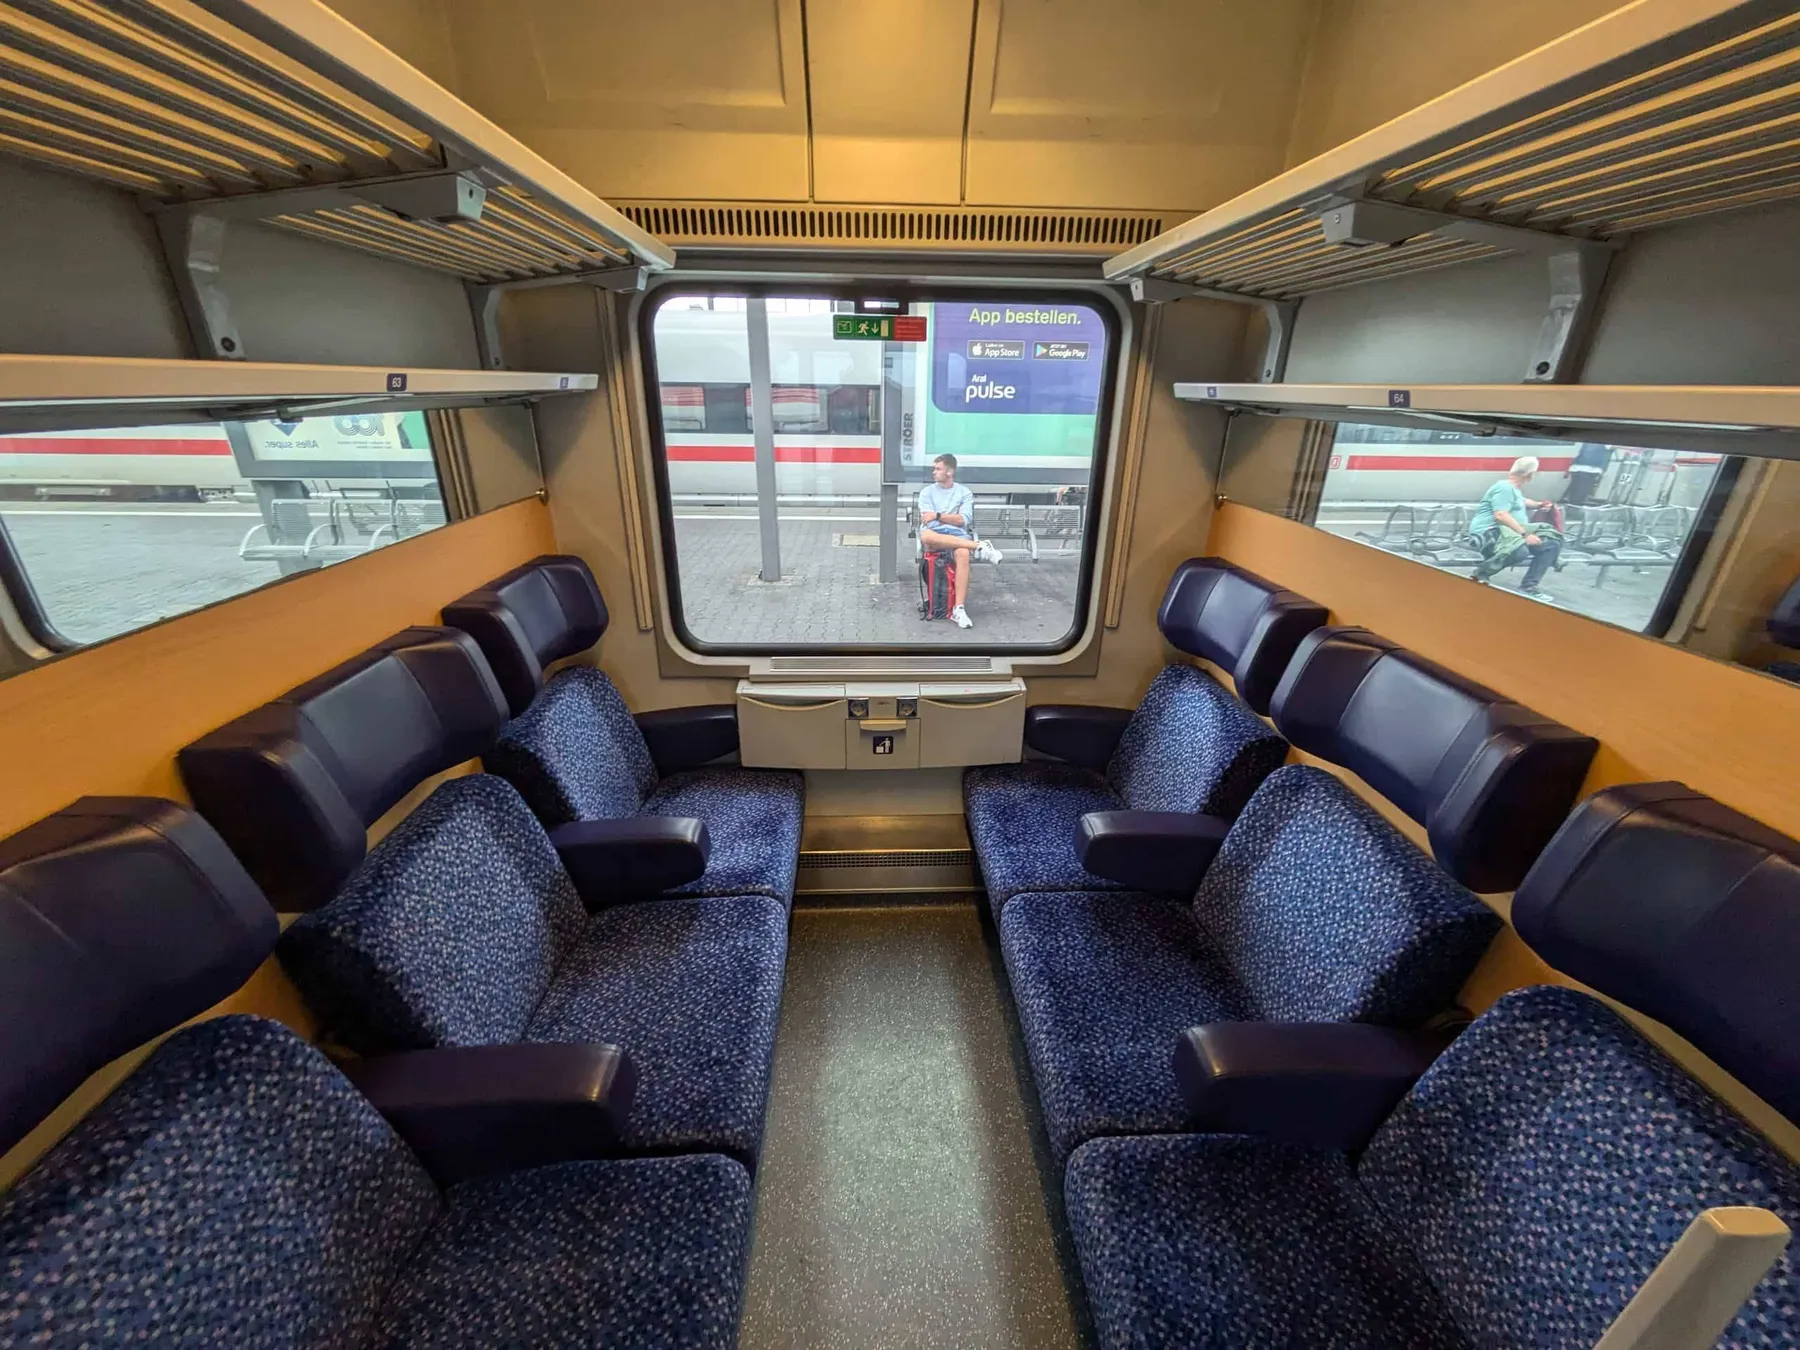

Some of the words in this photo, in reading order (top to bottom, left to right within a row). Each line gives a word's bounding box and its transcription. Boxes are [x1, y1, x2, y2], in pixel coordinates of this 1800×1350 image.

[969, 308, 1000, 326] App
[1005, 309, 1082, 325] bestellen.
[985, 349, 1000, 358] App
[1001, 348, 1020, 357] Store
[1048, 349, 1073, 358] Google
[1072, 349, 1086, 358] Play
[971, 374, 987, 383] Aral
[965, 381, 1016, 403] pulse
[1394, 393, 1404, 404] 64
